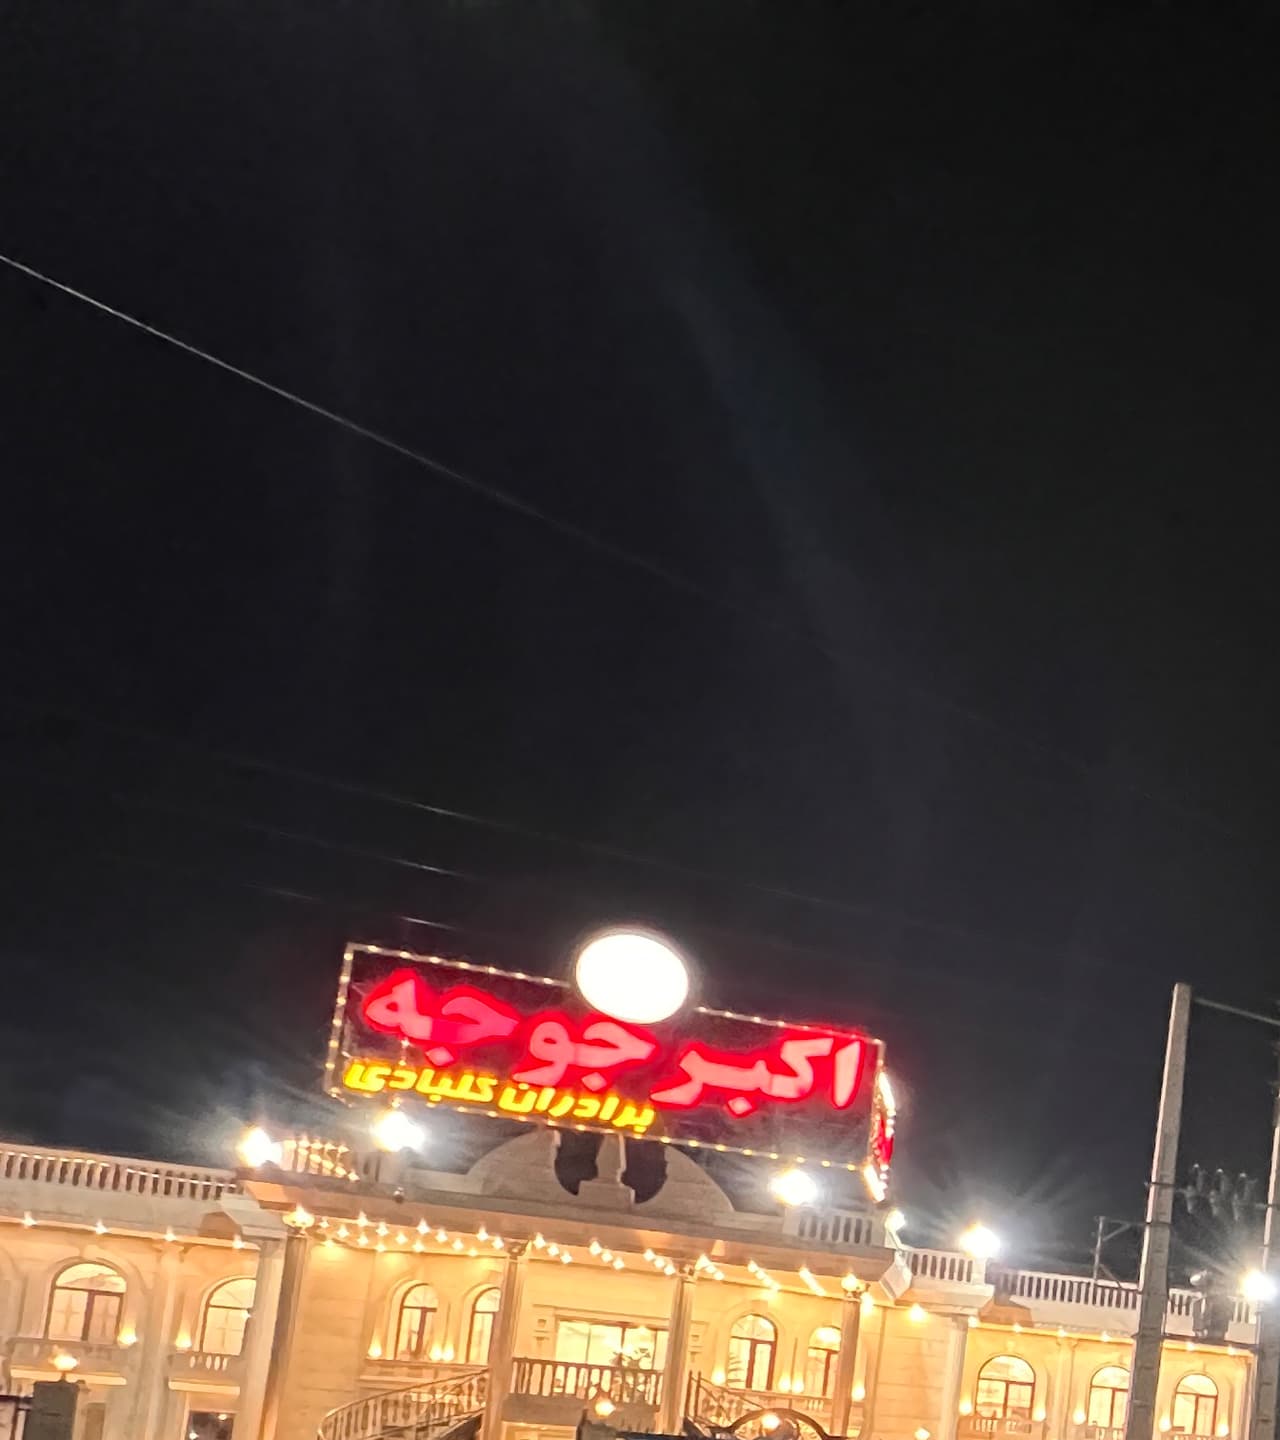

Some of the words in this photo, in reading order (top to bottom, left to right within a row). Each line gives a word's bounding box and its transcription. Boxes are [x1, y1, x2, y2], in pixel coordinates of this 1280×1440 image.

[363, 974, 661, 1092] جوجه
[343, 1063, 498, 1102] کلبادی
[498, 1082, 656, 1133] برادران
[650, 1035, 862, 1117] اکبر
